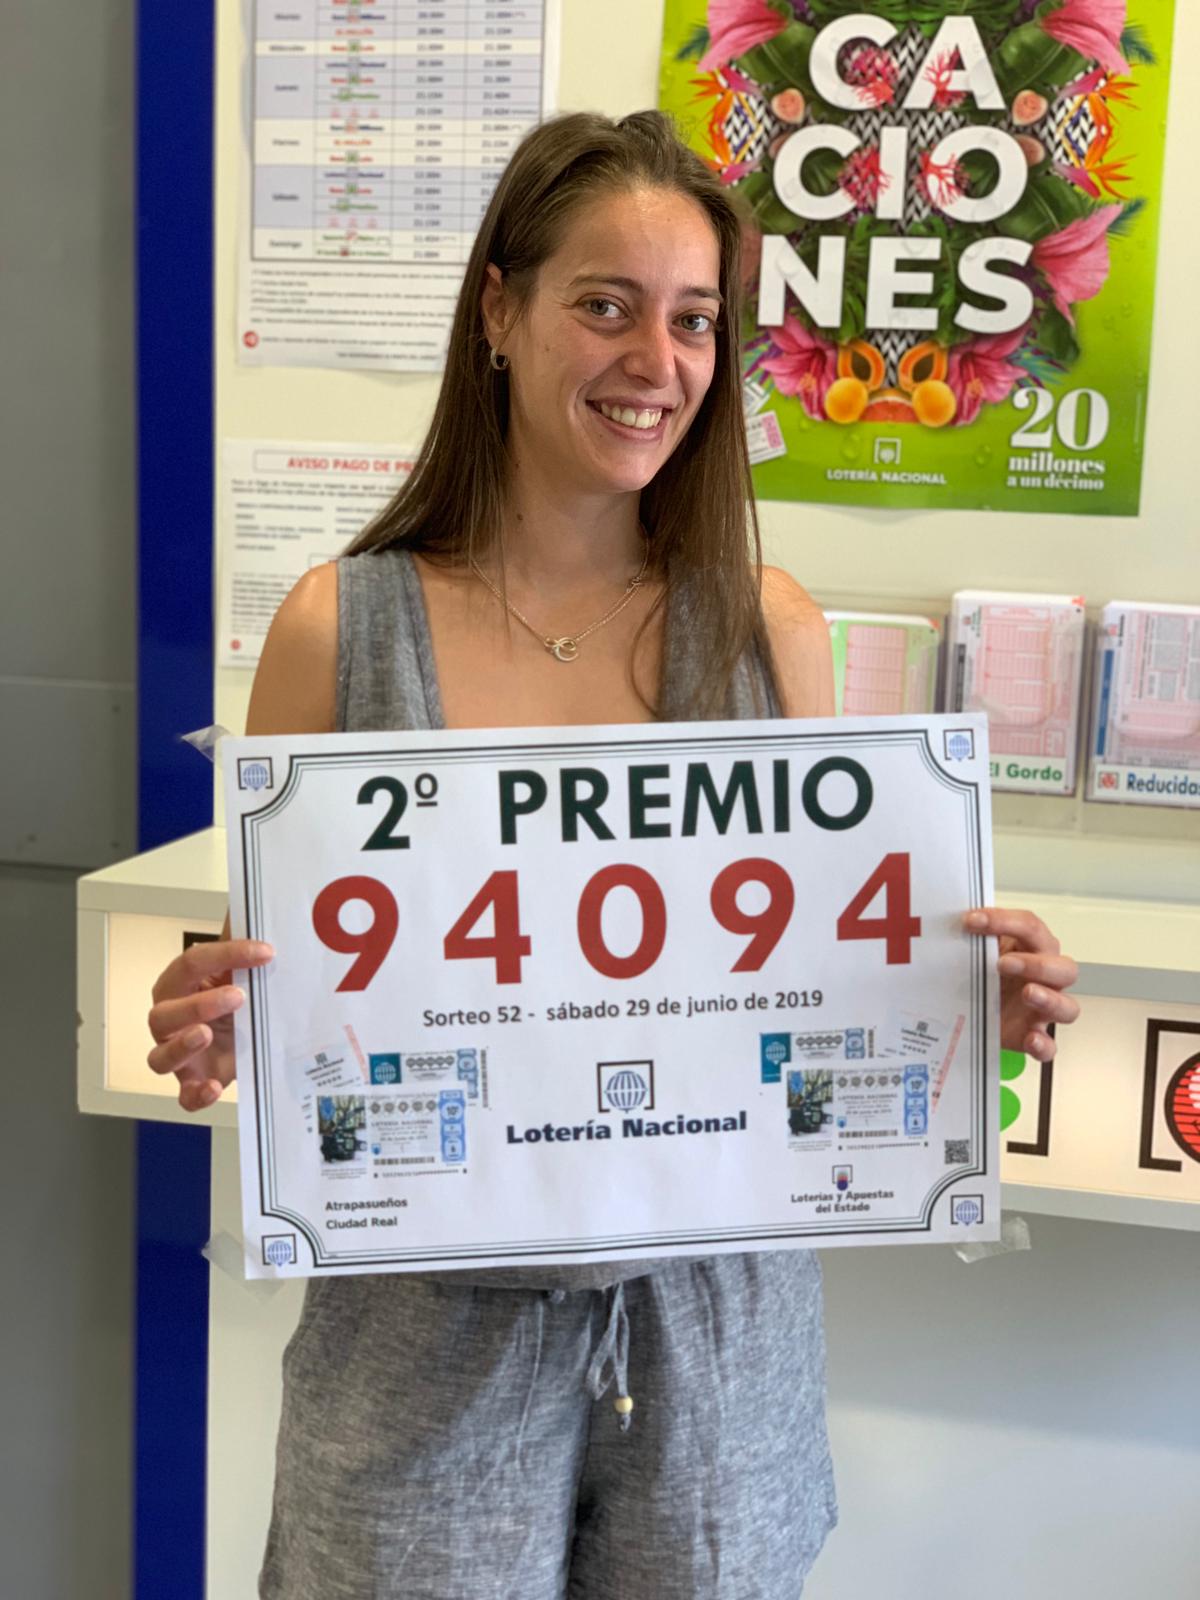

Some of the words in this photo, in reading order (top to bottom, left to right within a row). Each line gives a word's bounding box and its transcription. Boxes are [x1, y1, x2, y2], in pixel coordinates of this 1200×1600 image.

[808, 13, 1006, 113] CA
[771, 123, 1029, 223] CIO
[757, 234, 1035, 335] NES
[1009, 385, 1109, 451] 20
[287, 457, 330, 471] AVISO
[332, 458, 369, 473] PAGO
[373, 460, 390, 473] DE
[1009, 452, 1106, 475] millones
[826, 467, 878, 482] LOTERÍA
[881, 470, 947, 485] NACIONAL
[1006, 476, 1017, 487] a
[1019, 476, 1042, 487] un
[1043, 472, 1106, 491] décimo
[1006, 762, 1063, 782] Gordo
[356, 772, 439, 852] 2º
[498, 755, 875, 846] PREMIO
[423, 1009, 491, 1028] Sorteo
[497, 1005, 522, 1024] 52
[546, 1000, 620, 1021] sábado
[626, 998, 651, 1017] 29
[656, 997, 681, 1016] de
[686, 994, 738, 1018] junio
[744, 992, 769, 1011] de
[775, 989, 824, 1009] 2019
[506, 1120, 612, 1145] Lotería
[621, 1110, 747, 1139] Nacional
[325, 1197, 408, 1214] Atrapasueños
[835, 1194, 843, 1204] y
[845, 1188, 895, 1202] Apuestas
[815, 1202, 832, 1214] del
[834, 1201, 871, 1214] Estado
[325, 1216, 368, 1231] Ciudad
[371, 1215, 398, 1228] Real
